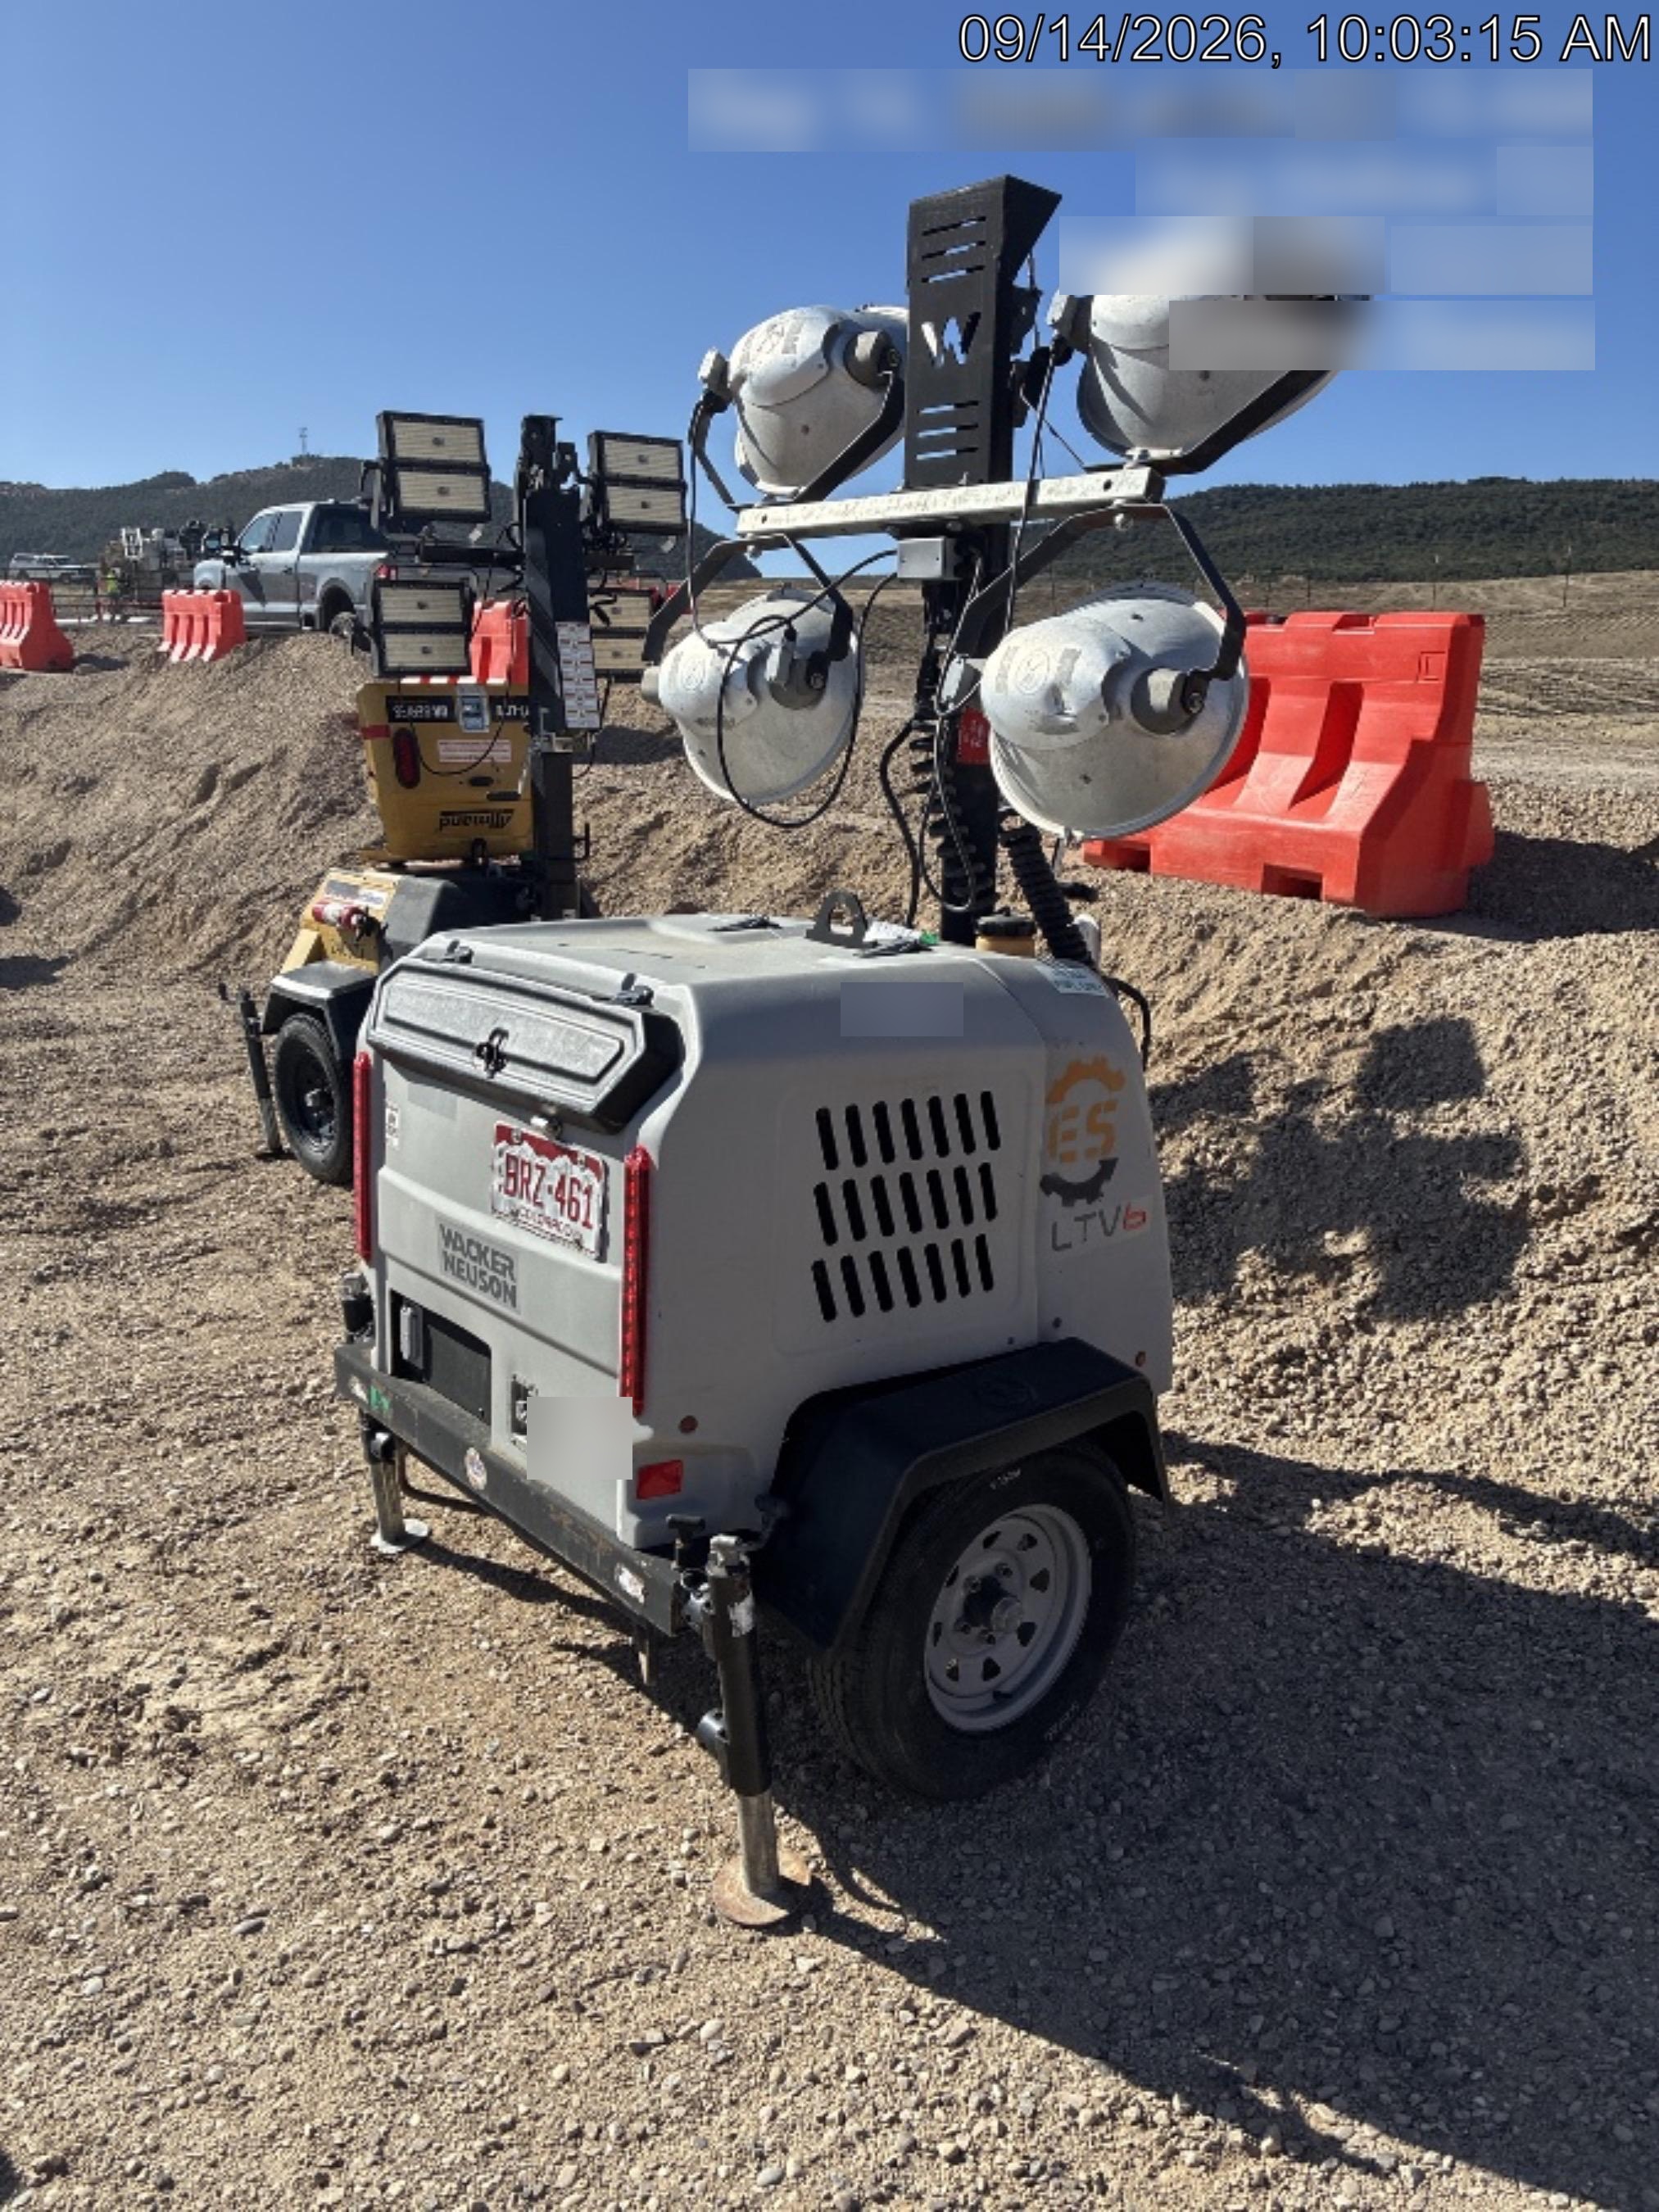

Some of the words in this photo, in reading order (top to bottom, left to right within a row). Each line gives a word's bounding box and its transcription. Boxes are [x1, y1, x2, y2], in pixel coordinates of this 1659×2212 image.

[1046, 1099, 1119, 1163] ES
[438, 1222, 517, 1284] WACKER
[442, 1249, 518, 1309] NEUSON
